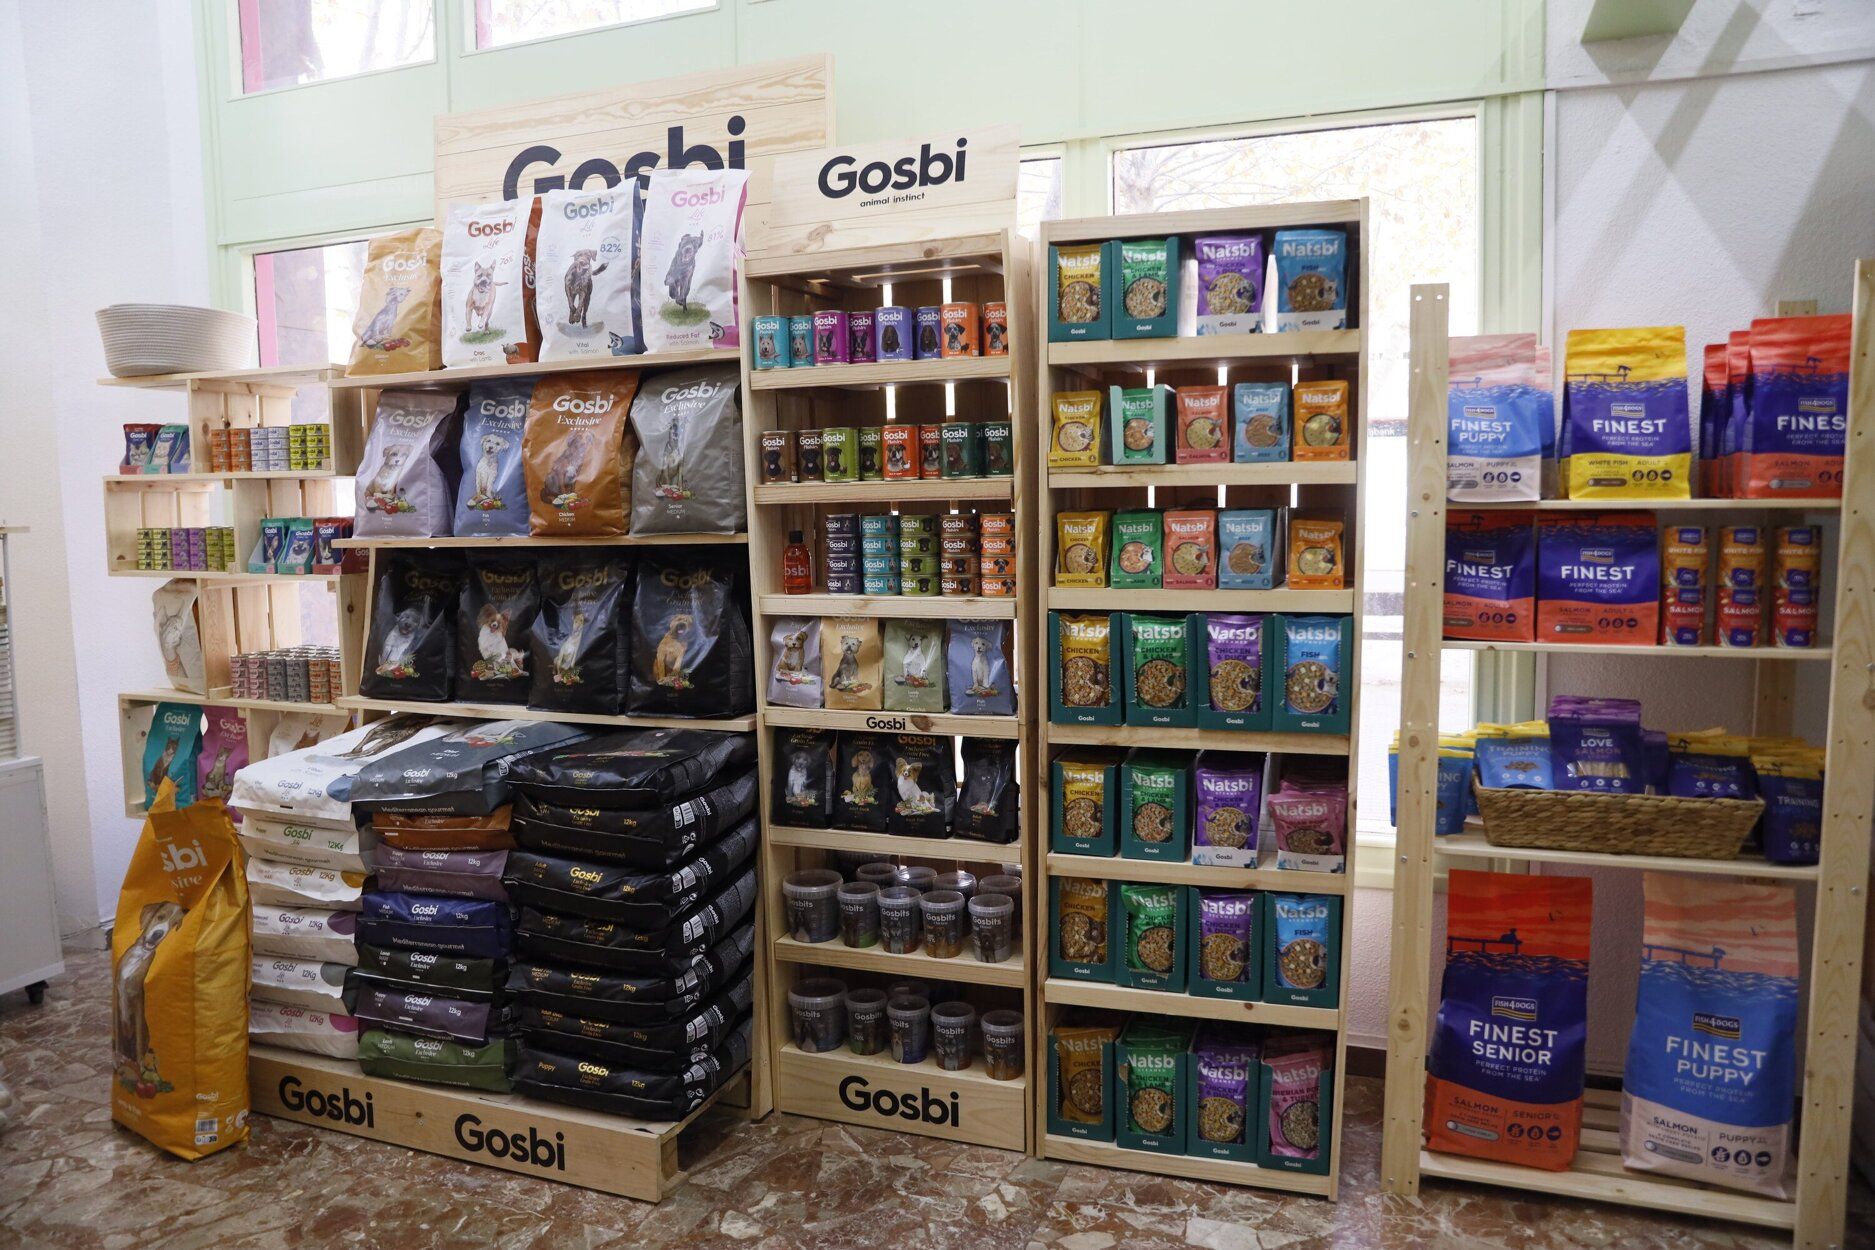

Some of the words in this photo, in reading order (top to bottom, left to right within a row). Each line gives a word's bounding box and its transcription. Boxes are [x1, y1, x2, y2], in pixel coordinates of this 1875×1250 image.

[817, 137, 969, 199] Gosbi
[671, 185, 726, 208] Gosbi
[860, 196, 891, 209] animal
[893, 192, 925, 204] instinct
[564, 196, 615, 221] Gosbi
[467, 217, 517, 238] Gosbi
[600, 243, 622, 253] 82%
[1203, 241, 1256, 260] Natsbi
[1283, 241, 1339, 257] Natsbi
[878, 312, 903, 321] Gosbi
[943, 309, 968, 319] Gosbi
[756, 321, 780, 331] Gosbi
[814, 316, 838, 326] Gosbi
[661, 381, 722, 404] Gosbi
[553, 394, 615, 414] Gosbi
[664, 400, 706, 414] Exclusive
[1059, 401, 1094, 414] Natsbi
[1184, 395, 1221, 408] Natsbi
[480, 399, 531, 419] Gosbi
[480, 417, 523, 430] Exclusive
[557, 415, 602, 426] Exclusive
[1452, 420, 1513, 433] FINEST
[1593, 419, 1667, 434] FINEST
[823, 433, 846, 442] Gosbi
[884, 431, 908, 440] Gosbi
[942, 428, 968, 438] Gosbi
[985, 428, 1009, 437] Gosbi
[1459, 432, 1506, 443] PUPPY
[762, 438, 785, 446] Gosbi
[943, 520, 964, 528] Gosbi
[983, 520, 1006, 528] Gosbi
[1064, 524, 1096, 534] Natsbi
[1119, 524, 1153, 534] Natsbi
[1171, 522, 1207, 533] Natsbi
[1226, 522, 1263, 533] Natsbi
[863, 541, 881, 549] Gosbi
[944, 541, 966, 549] Gosbi
[1447, 560, 1514, 579] FINEST
[1561, 565, 1635, 580] FINEST
[1723, 607, 1760, 615] SALMON
[164, 712, 191, 726] Gosbi
[866, 717, 906, 731] Gosbi
[1581, 738, 1614, 748] LOVE
[404, 768, 431, 778] Gosbi
[278, 779, 303, 789] Gosbi
[1203, 778, 1253, 792] Natsbi
[1276, 803, 1328, 816] Natsbi
[283, 826, 314, 841] Gosbi
[328, 840, 344, 851] 12Kg
[468, 859, 481, 867] 12kg
[289, 867, 316, 876] Gosbi
[319, 871, 336, 881] 12Kg
[570, 866, 604, 883] Gosbi
[412, 904, 439, 915] Gosbi
[455, 913, 469, 921] 12kg
[881, 908, 910, 918] Gosbits
[926, 913, 956, 922] Gosbits
[308, 920, 323, 931] 12Kg
[973, 916, 1002, 926] Gosbits
[410, 952, 439, 964] Gosbi
[456, 963, 468, 972] 12kg
[273, 961, 298, 972] Gosbi
[302, 969, 317, 981] 12Kg
[623, 984, 637, 992] 12kg
[404, 994, 433, 1006] Gosbi
[448, 1007, 462, 1016] 12kg
[1494, 1000, 1536, 1010] FISH4DOGS
[280, 1007, 305, 1018] Gosbi
[309, 1014, 324, 1026] 12Kg
[936, 1026, 965, 1035] Gosbits
[1469, 1020, 1558, 1048] FINEST
[986, 1034, 1016, 1044] Gosbits
[414, 1039, 445, 1050] Gosbi
[462, 1050, 476, 1058] 12kg
[1472, 1040, 1552, 1066] SENIOR
[1666, 1036, 1767, 1070] FINEST
[538, 1062, 556, 1072] Puppy
[1475, 1059, 1511, 1072] PERFECT
[1513, 1065, 1547, 1077] PROTEIN
[1677, 1059, 1755, 1087] PUPPY
[1481, 1068, 1504, 1077] FROM
[1507, 1073, 1521, 1081] THE
[1524, 1074, 1541, 1082] SEA
[1674, 1078, 1713, 1091] PERFECT
[1680, 1086, 1706, 1097] FROM
[278, 1075, 375, 1128] Gosbi
[838, 1075, 959, 1128] Gosbi
[1454, 1096, 1499, 1114] SALMON
[1653, 1116, 1698, 1135] SALMON
[1719, 1133, 1756, 1144] PUPPY
[453, 1113, 565, 1171] Gosbi
